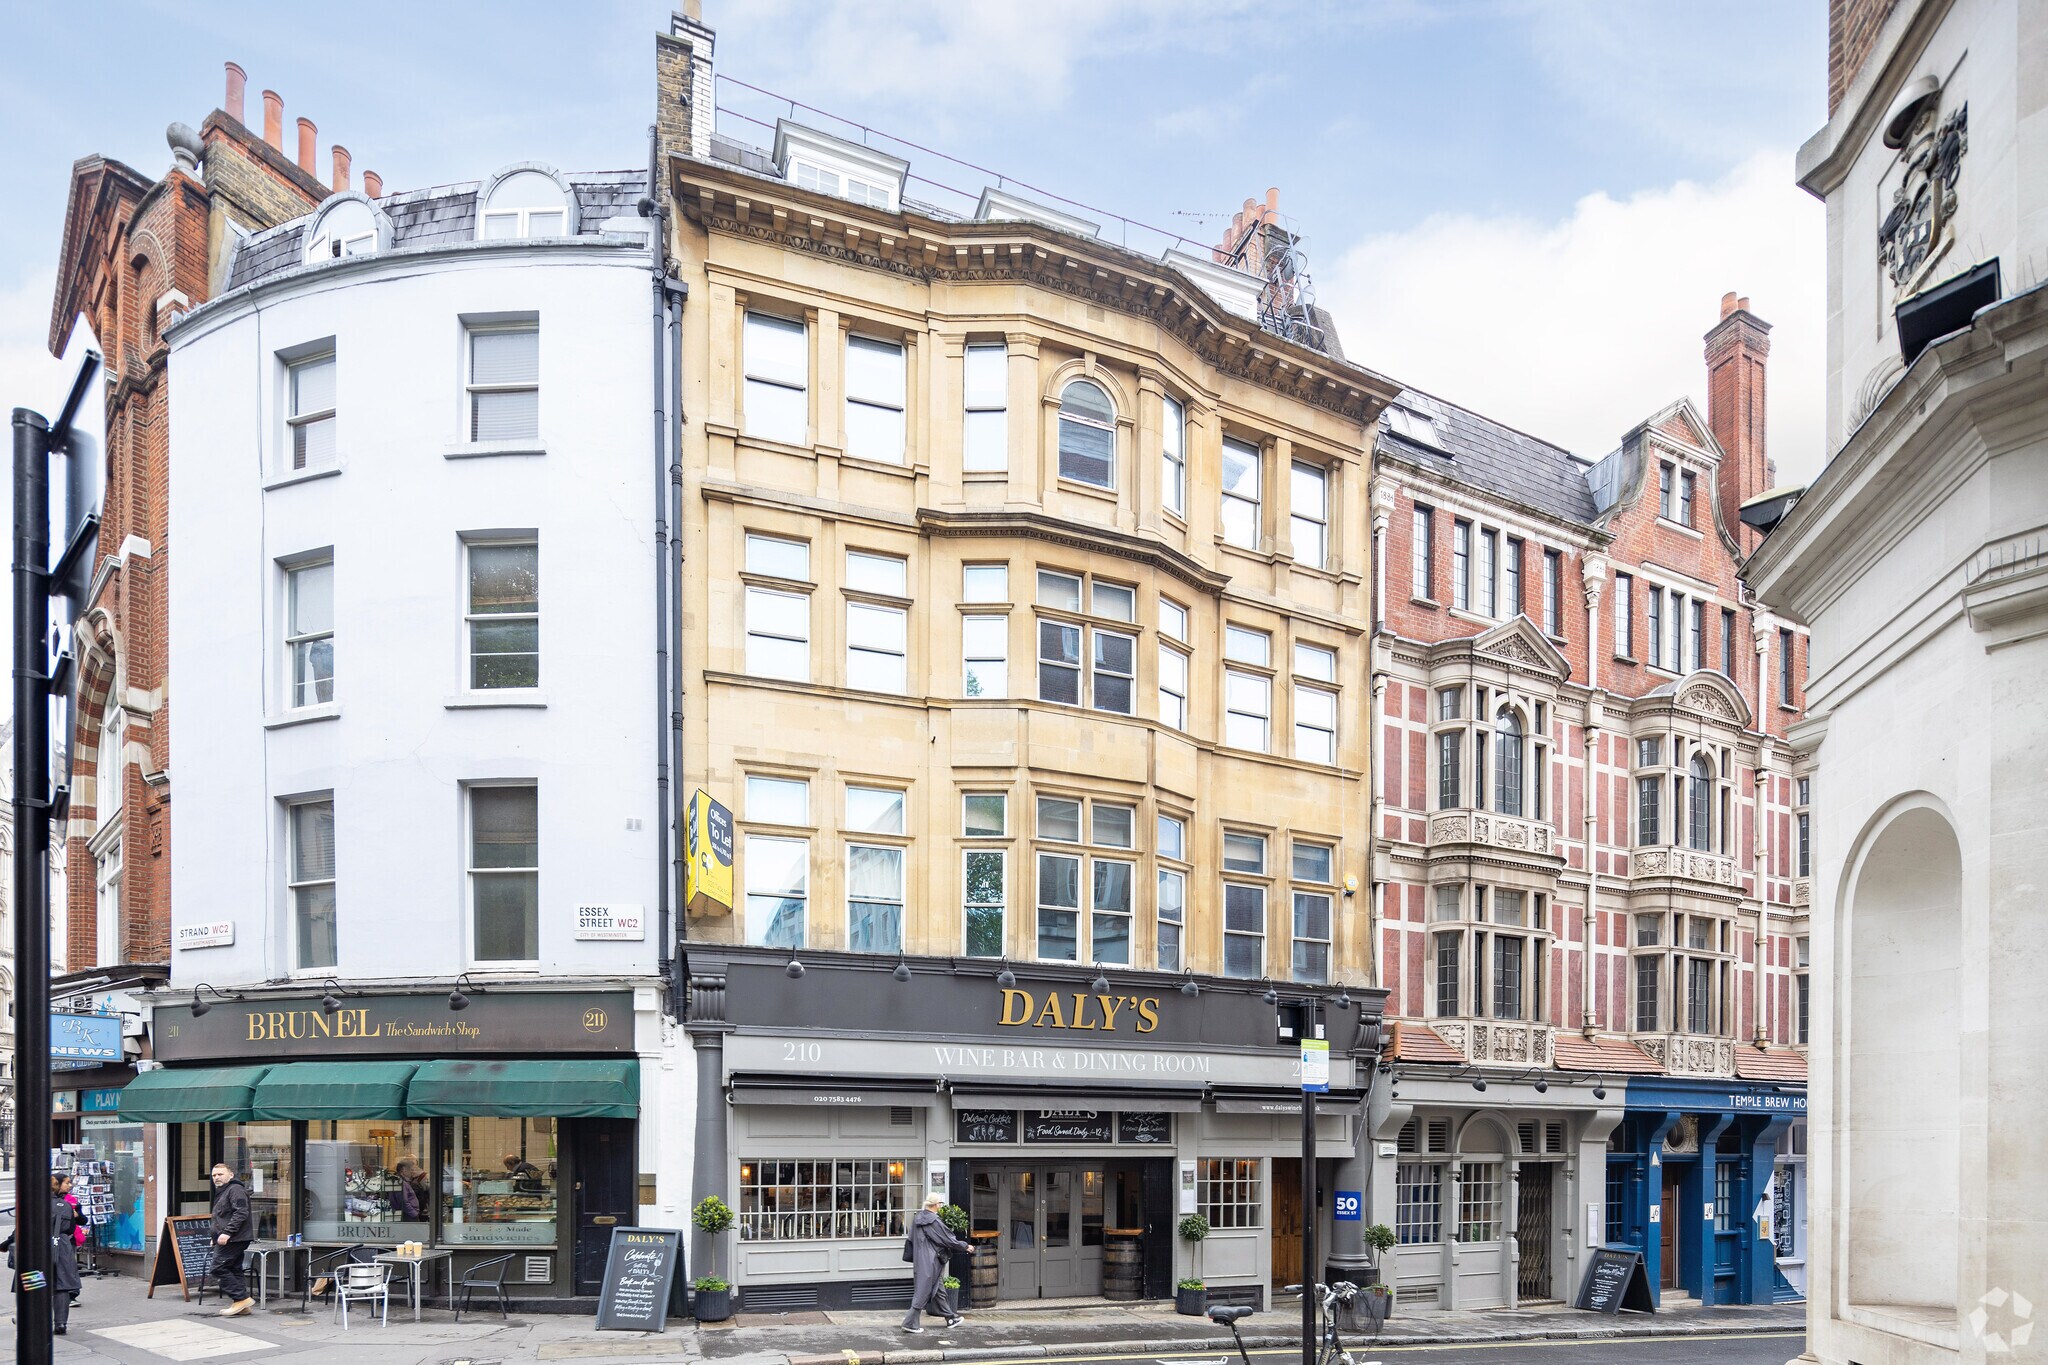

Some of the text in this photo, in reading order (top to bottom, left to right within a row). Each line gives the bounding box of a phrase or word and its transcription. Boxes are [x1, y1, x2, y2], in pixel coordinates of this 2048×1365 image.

[710, 808, 727, 828] Offices
[710, 821, 720, 840] To
[721, 829, 732, 849] Let
[579, 907, 609, 917] ESSEX
[579, 918, 639, 928] STREET WC2
[180, 924, 229, 938] STRAND WC2
[998, 988, 1161, 1034] DALY'S
[245, 1008, 380, 1041] BRUNEL
[585, 1012, 605, 1028] 211
[385, 1016, 481, 1039] The Sandwich Shop.
[51, 1046, 116, 1057] NEWS
[783, 1042, 821, 1062] 210
[934, 1047, 1211, 1074] WINE BAR & DINING ROOM
[95, 1093, 116, 1107] PLAY
[828, 1095, 845, 1103] 7583
[845, 1095, 862, 1103] 4476
[1728, 1095, 1808, 1109] TEMPLE BREW HO
[1036, 1124, 1054, 1137] Food
[1053, 1124, 1074, 1137] Served
[1336, 1197, 1358, 1210] 50
[337, 1226, 396, 1238] BRUNEL
[627, 1234, 664, 1244] DALY'S
[624, 1249, 657, 1262] Celebrate
